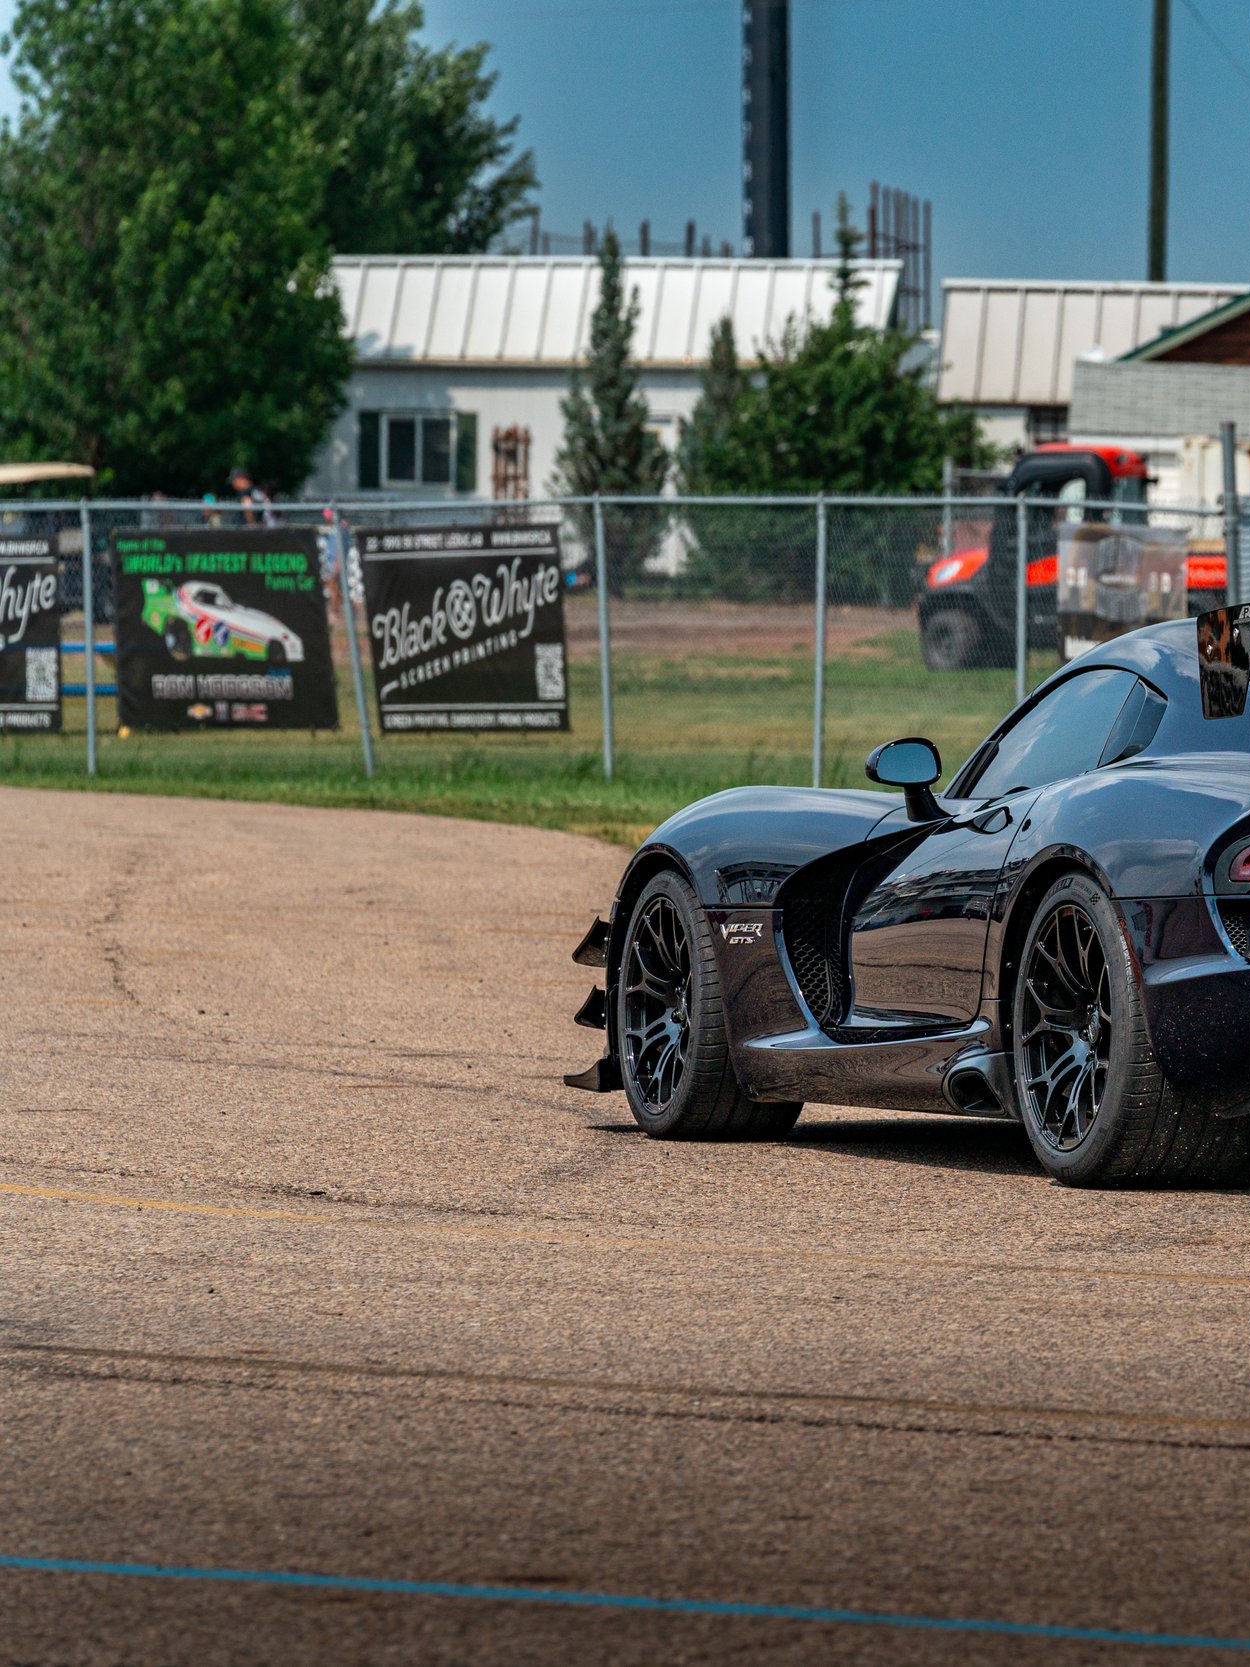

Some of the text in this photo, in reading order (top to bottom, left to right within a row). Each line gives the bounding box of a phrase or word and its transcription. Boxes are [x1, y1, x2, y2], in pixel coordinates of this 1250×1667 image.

[0, 565, 57, 644] hyte
[372, 587, 448, 670] Black
[472, 557, 559, 640] Whyte
[400, 629, 518, 690] SCREEN PRINTING
[720, 924, 763, 940] VIPER
